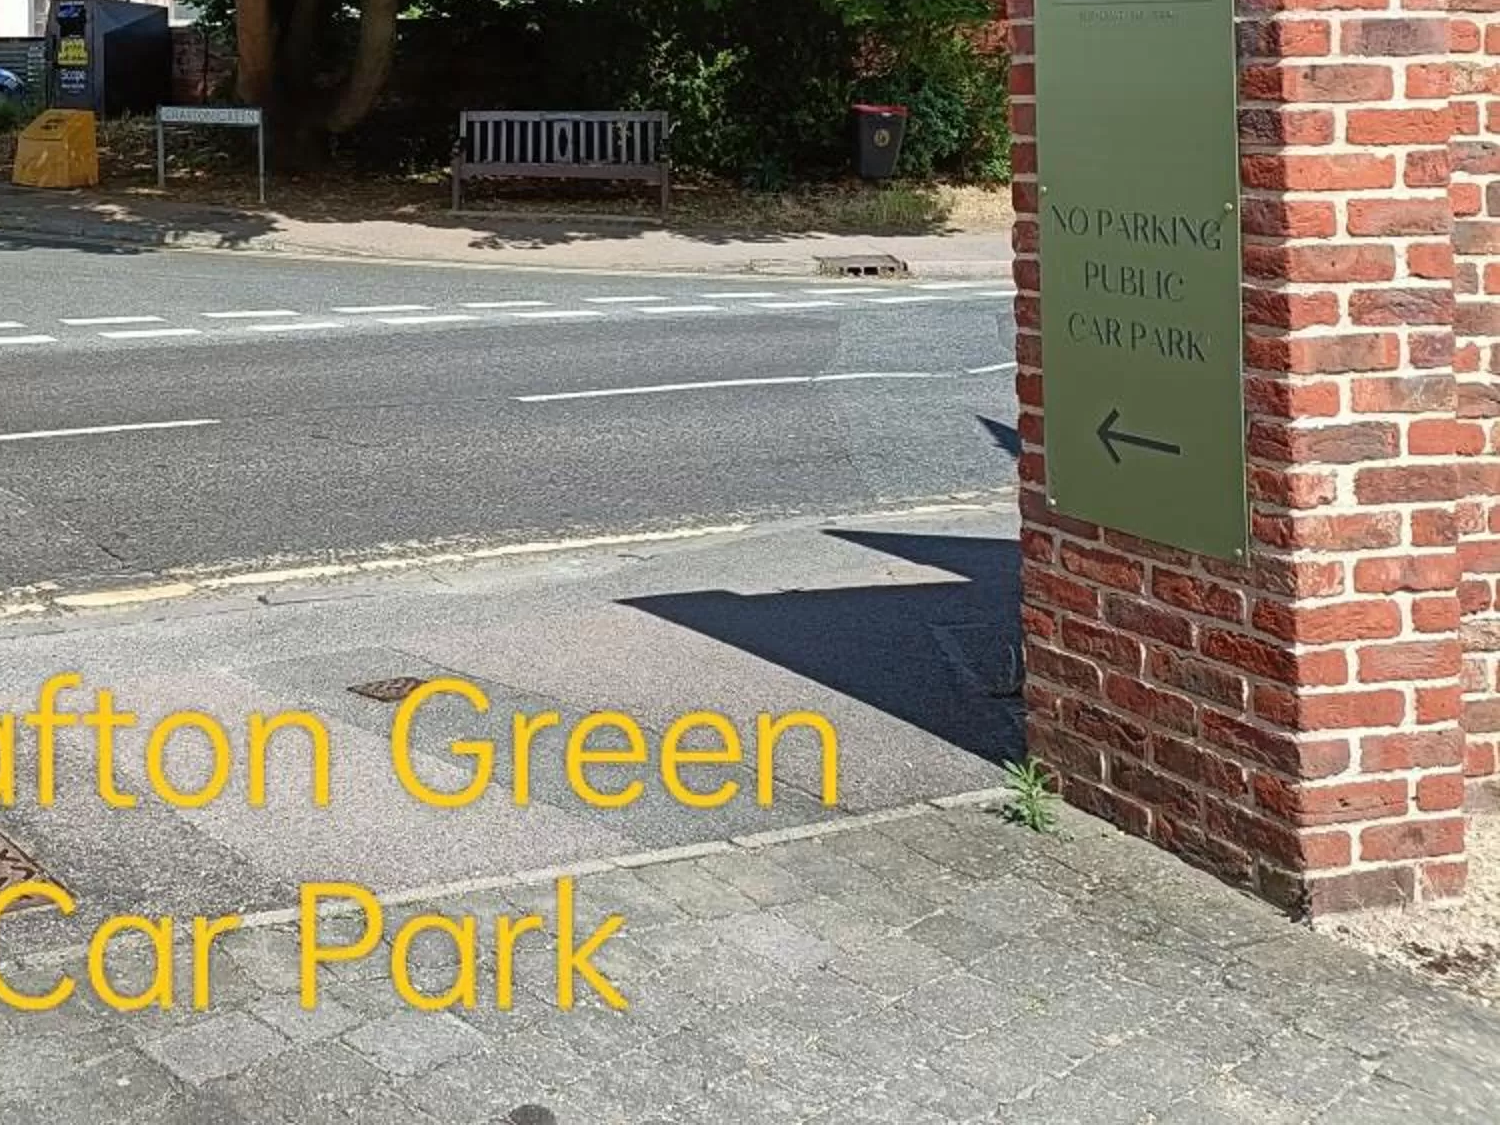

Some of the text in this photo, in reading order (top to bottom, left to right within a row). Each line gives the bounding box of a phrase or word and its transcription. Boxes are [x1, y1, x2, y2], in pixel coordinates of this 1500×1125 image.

[1051, 203, 1221, 251] NO PARKING
[1085, 260, 1184, 302] PUBLIC
[1068, 311, 1205, 362] CAR PARK
